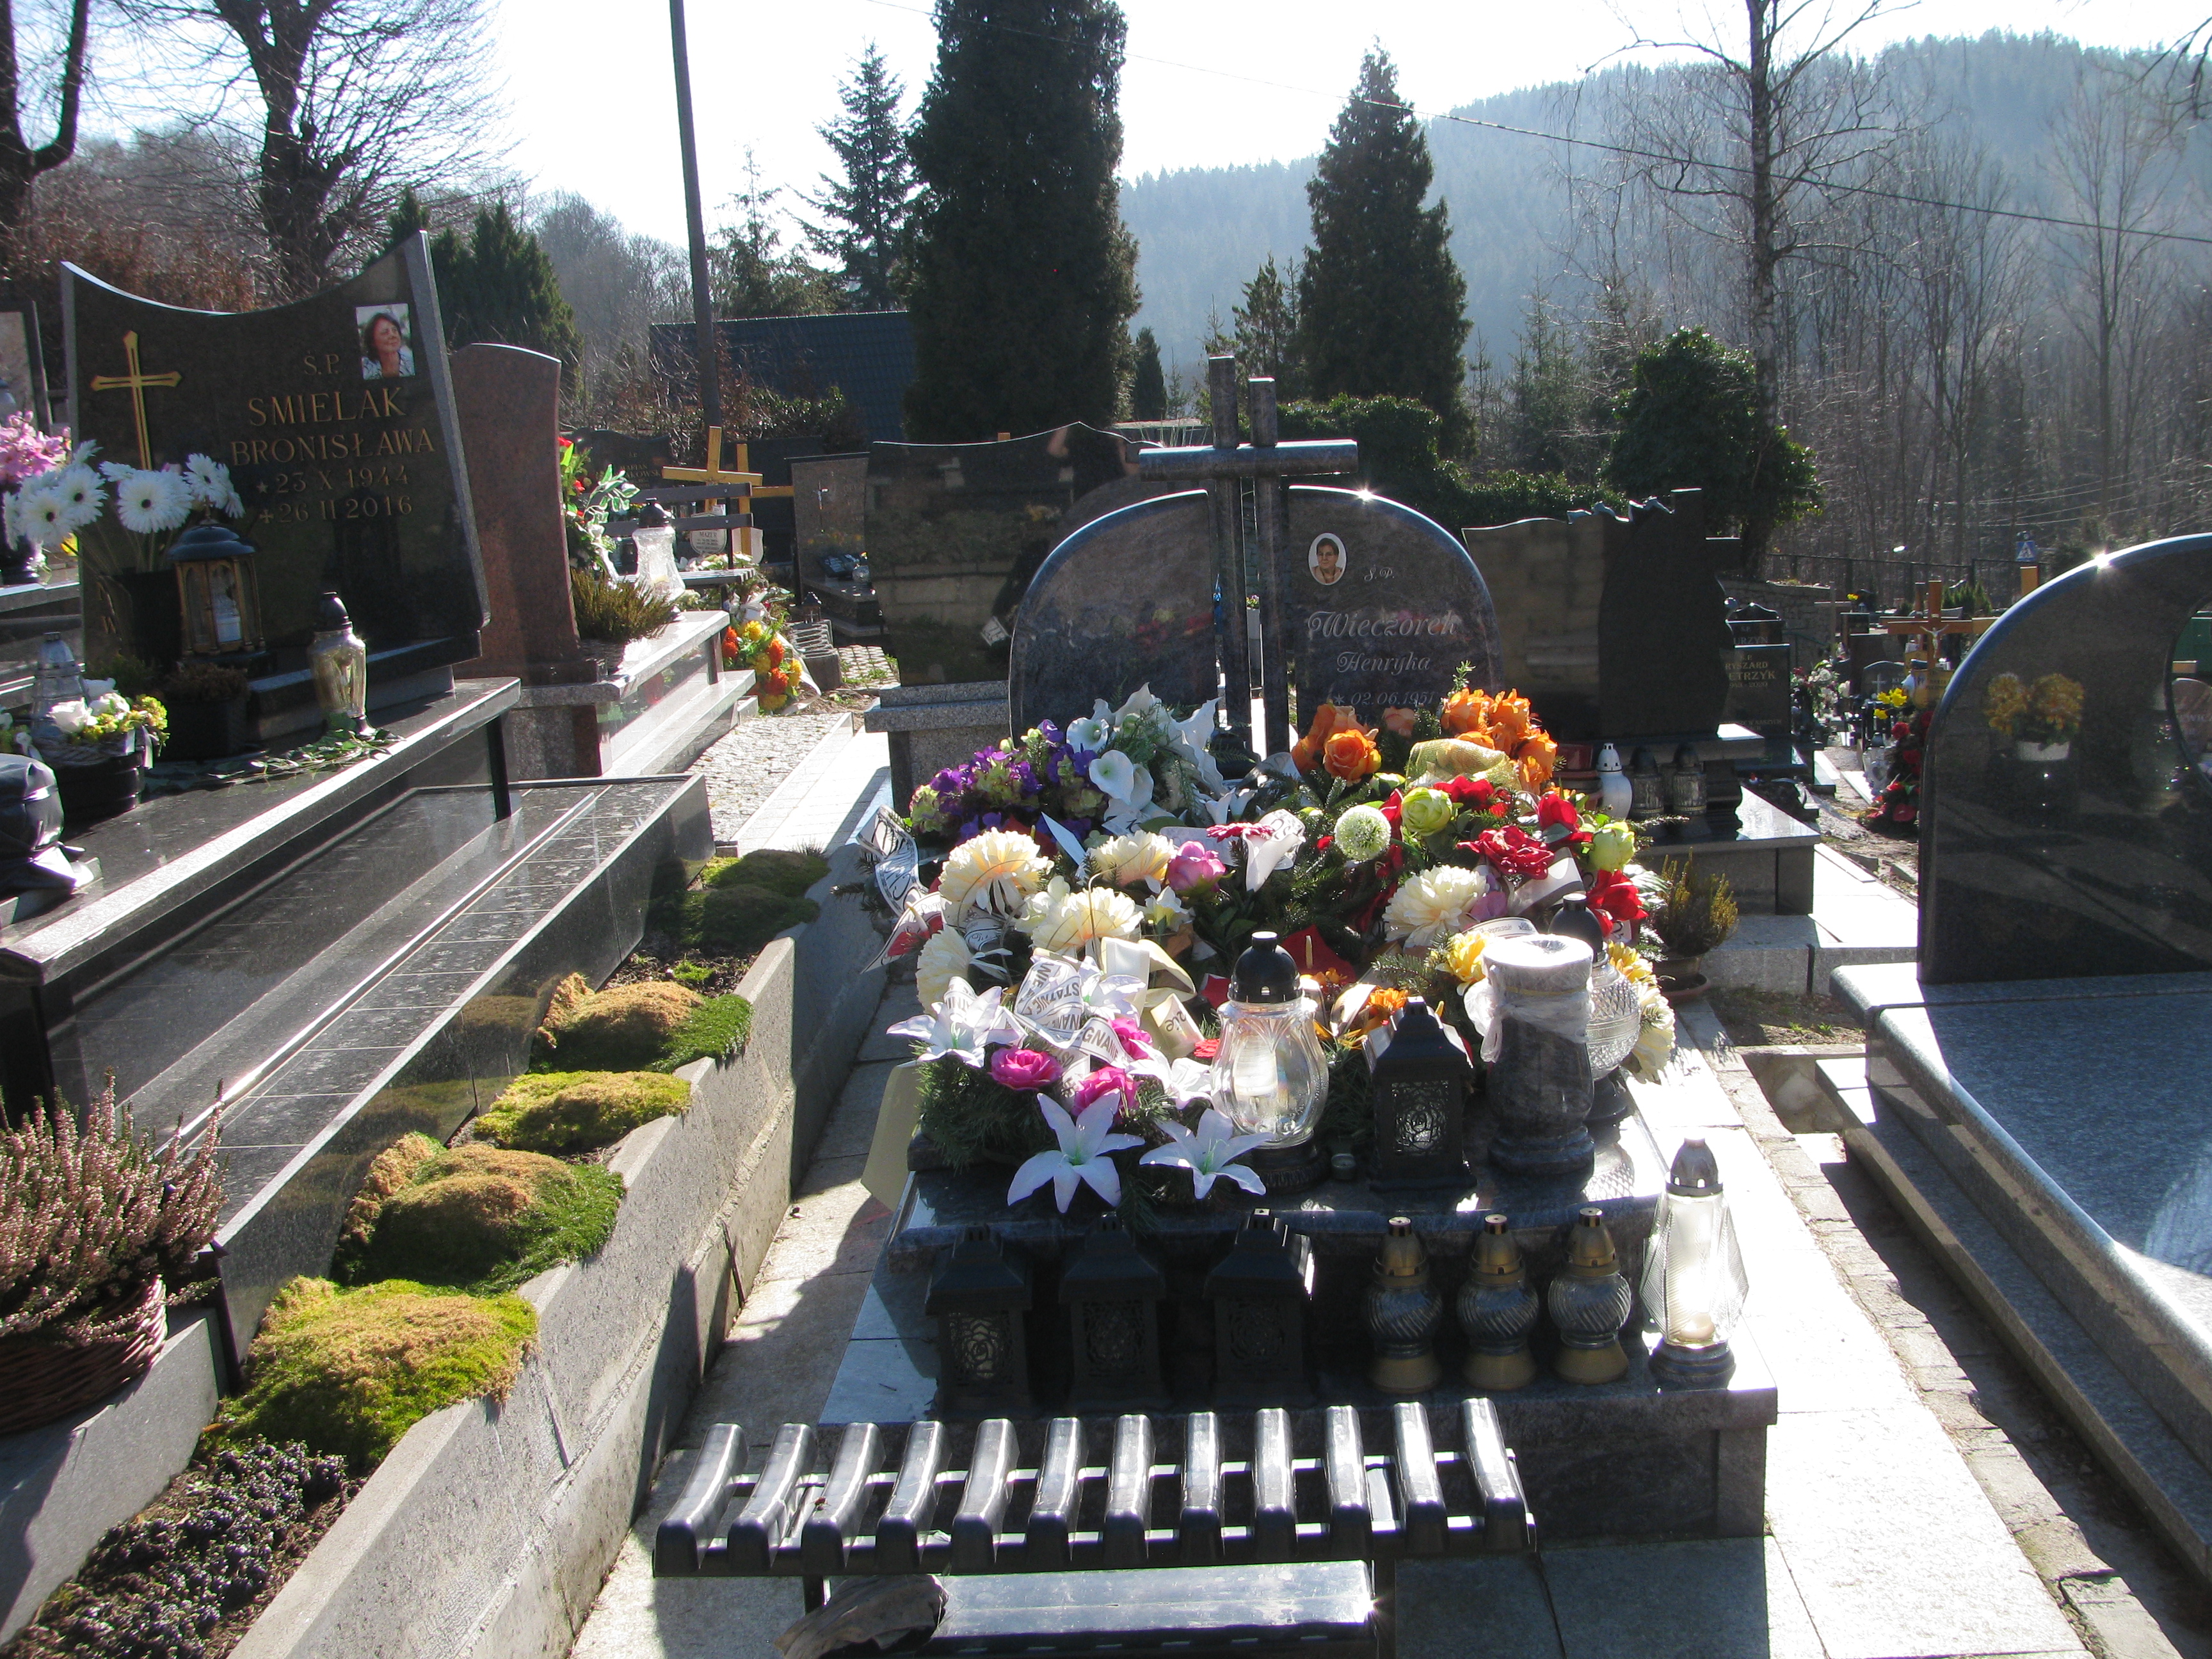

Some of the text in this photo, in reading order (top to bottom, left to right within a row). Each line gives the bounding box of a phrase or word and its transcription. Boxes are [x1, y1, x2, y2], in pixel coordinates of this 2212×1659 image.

[247, 387, 406, 426] SMIELAK
[230, 428, 436, 466] BRONISŁAWA
[319, 470, 333, 490] X
[347, 465, 409, 488] 1944
[278, 495, 413, 523] 26 II 2016
[1308, 609, 1457, 638] Wieczorek
[1336, 651, 1431, 676] Henryka
[1726, 661, 1768, 670] RYSZARD
[1729, 670, 1777, 681] ETRZYK
[1082, 1026, 1119, 1060] GNANIE
